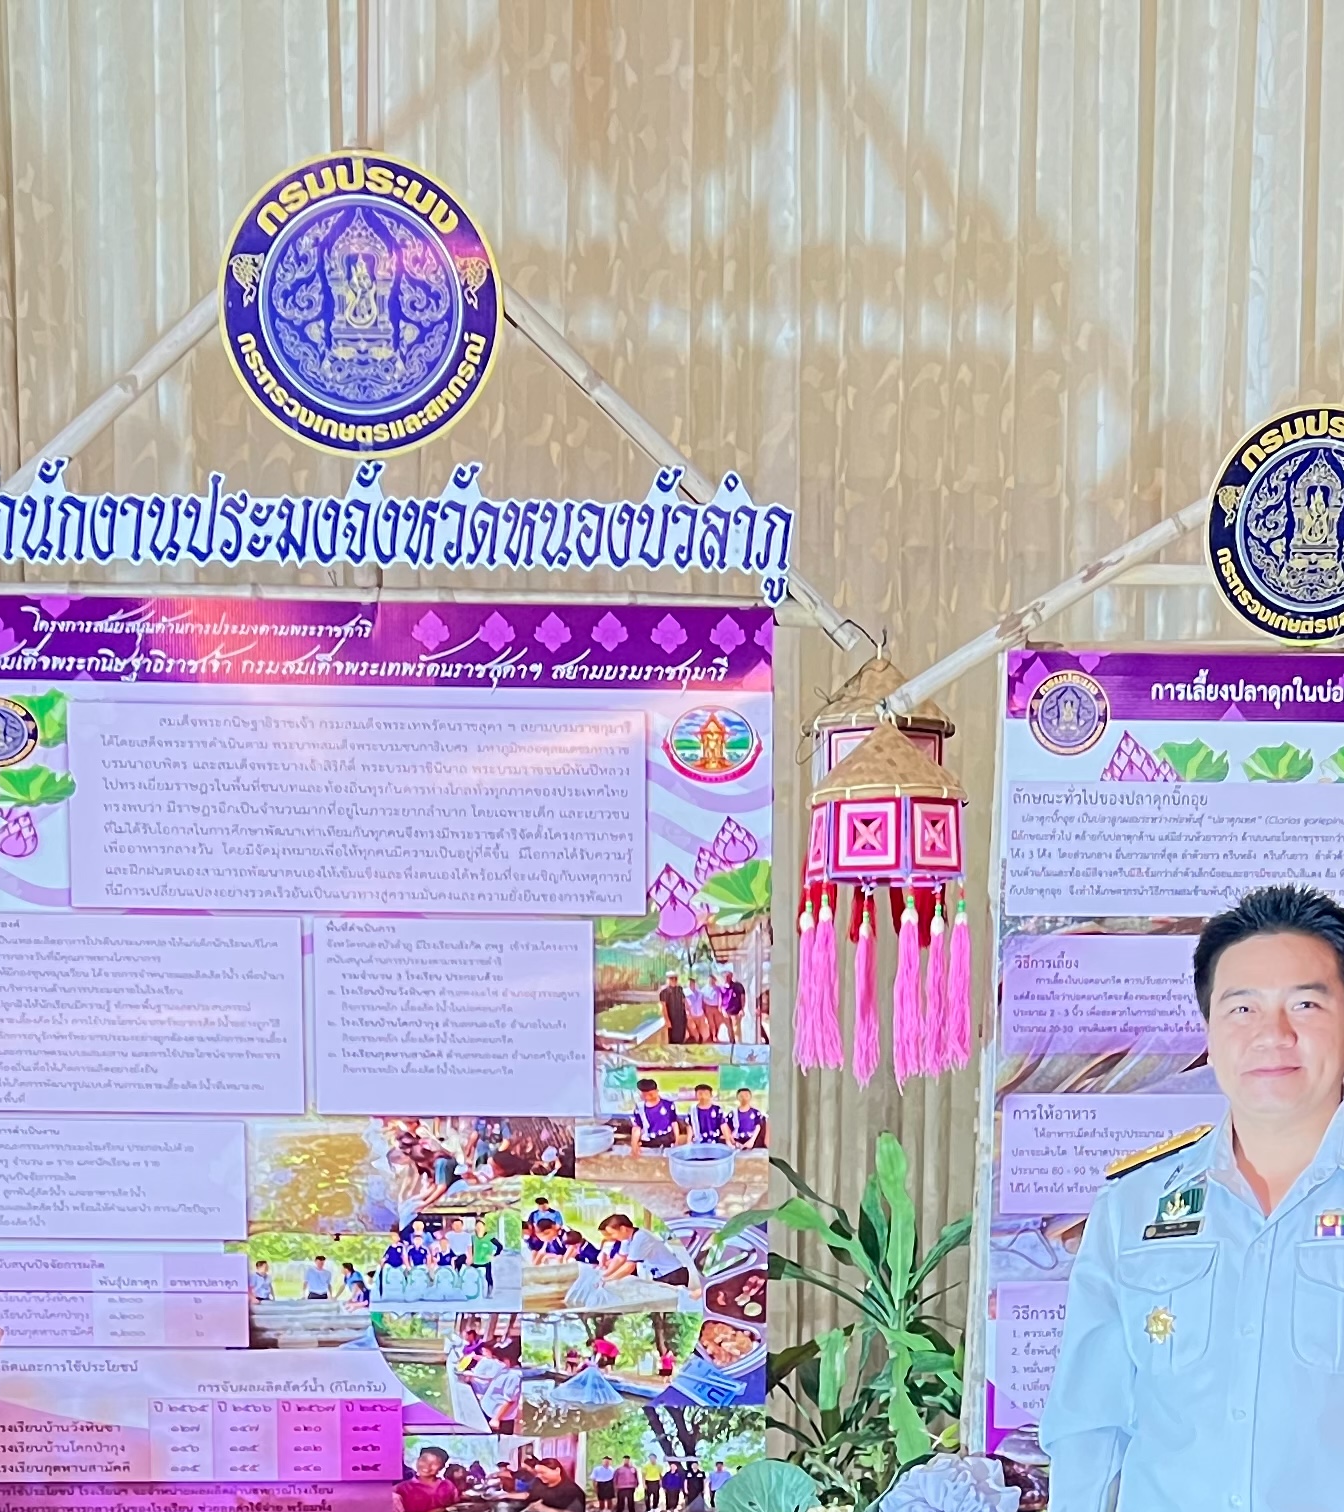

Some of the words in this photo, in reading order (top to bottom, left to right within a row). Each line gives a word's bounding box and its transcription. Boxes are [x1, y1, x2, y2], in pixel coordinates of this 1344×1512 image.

[254, 157, 461, 240] กรมประมง
[235, 331, 484, 445] กระทรวงเกษตรและสหกรณ์
[552, 649, 729, 697] สยามบรมราชกุมารี
[1013, 784, 1208, 810] ลักษณะทั่วไปของปลาดุกบิ๊กอุย
[1013, 1104, 1097, 1120] การให้อาหาร
